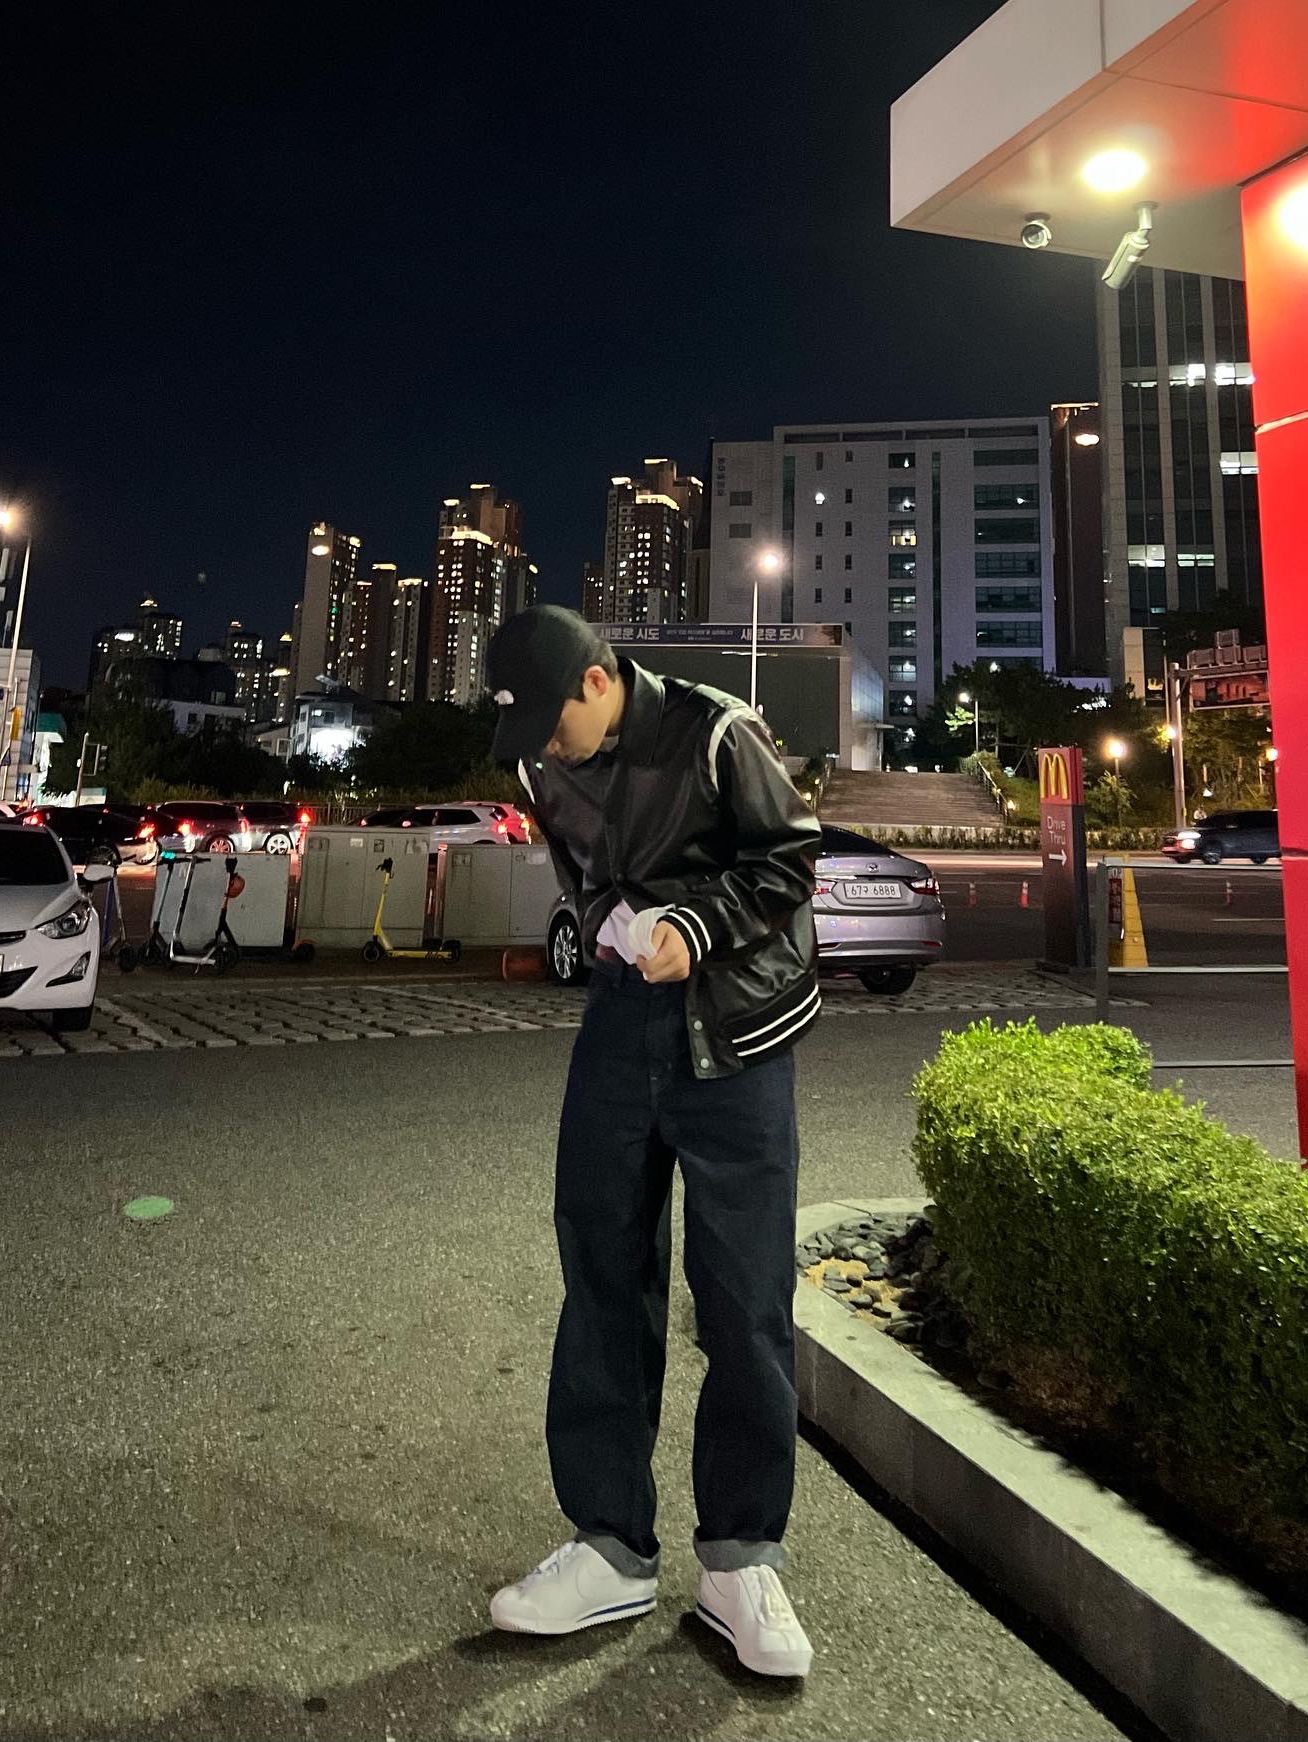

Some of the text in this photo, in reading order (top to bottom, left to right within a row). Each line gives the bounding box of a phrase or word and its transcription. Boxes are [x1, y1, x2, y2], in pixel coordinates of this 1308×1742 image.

[636, 628, 660, 641] 시도
[740, 628, 776, 641] 새로운
[779, 628, 804, 641] 도시
[1047, 816, 1066, 830] Drive
[1048, 830, 1066, 845] Thru
